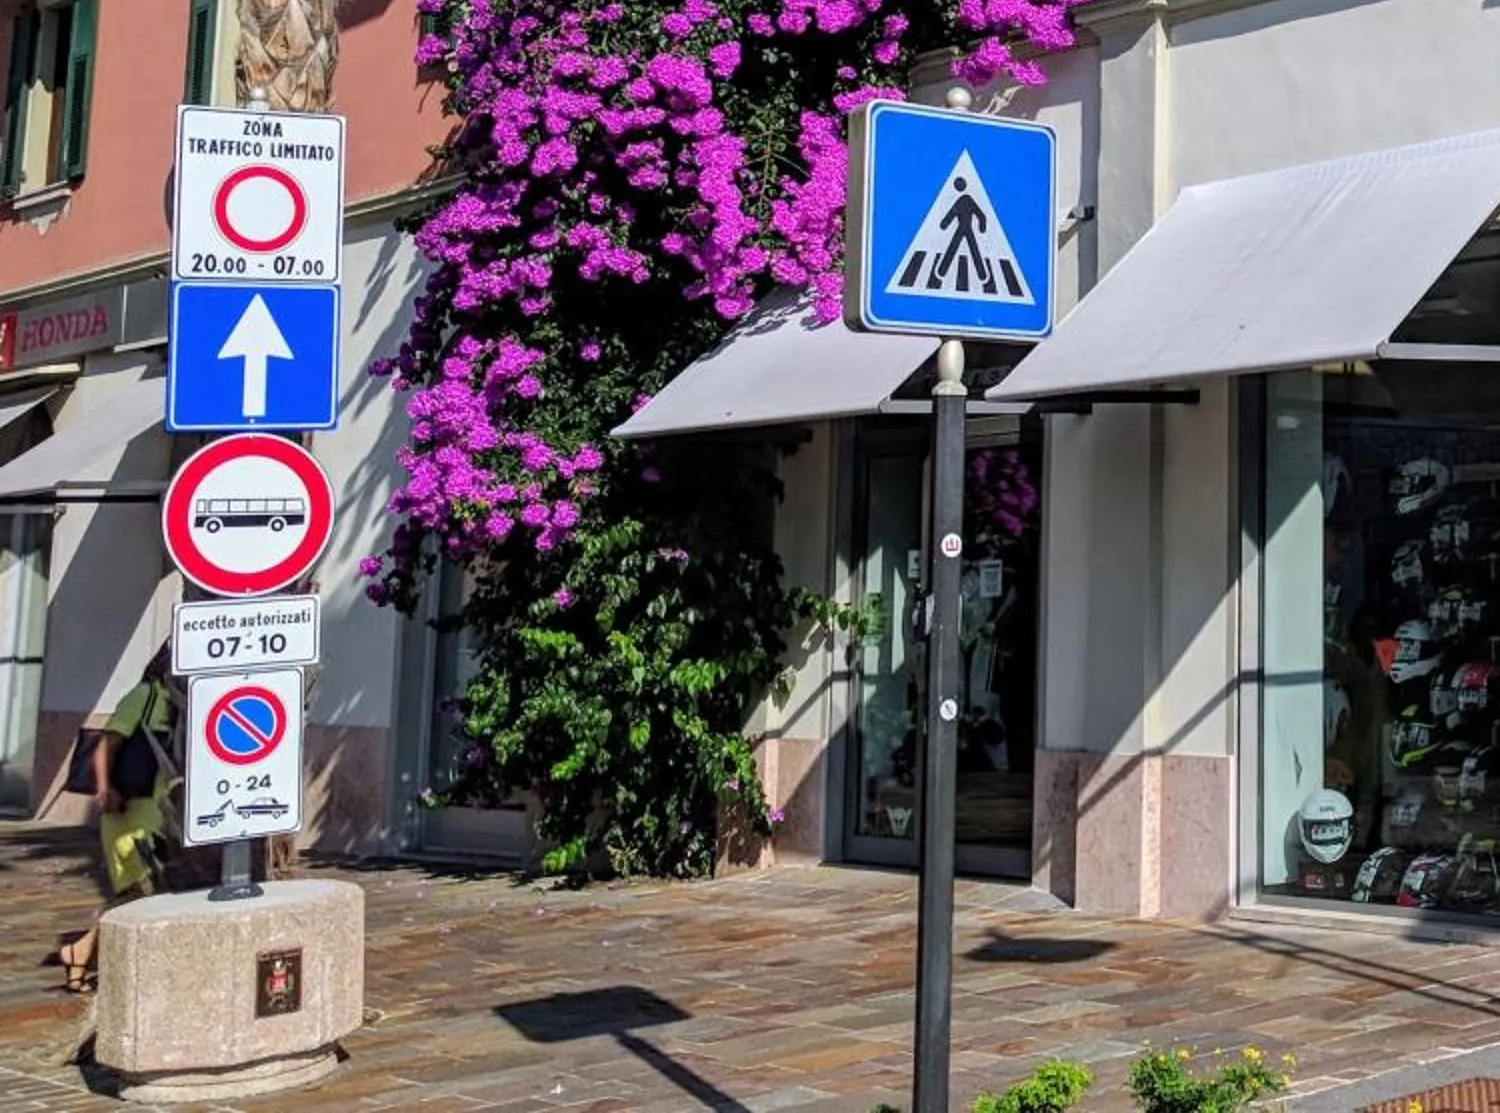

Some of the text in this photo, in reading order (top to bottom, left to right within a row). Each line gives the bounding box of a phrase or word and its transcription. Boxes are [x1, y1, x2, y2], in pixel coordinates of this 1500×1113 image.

[243, 120, 283, 137] ZONA
[189, 138, 335, 162] TRAFFICO LIMITATO
[191, 253, 247, 275] 20.00
[273, 256, 324, 276] 07.00
[21, 304, 110, 353] HONDA
[183, 610, 312, 631] eccetto autorizzati
